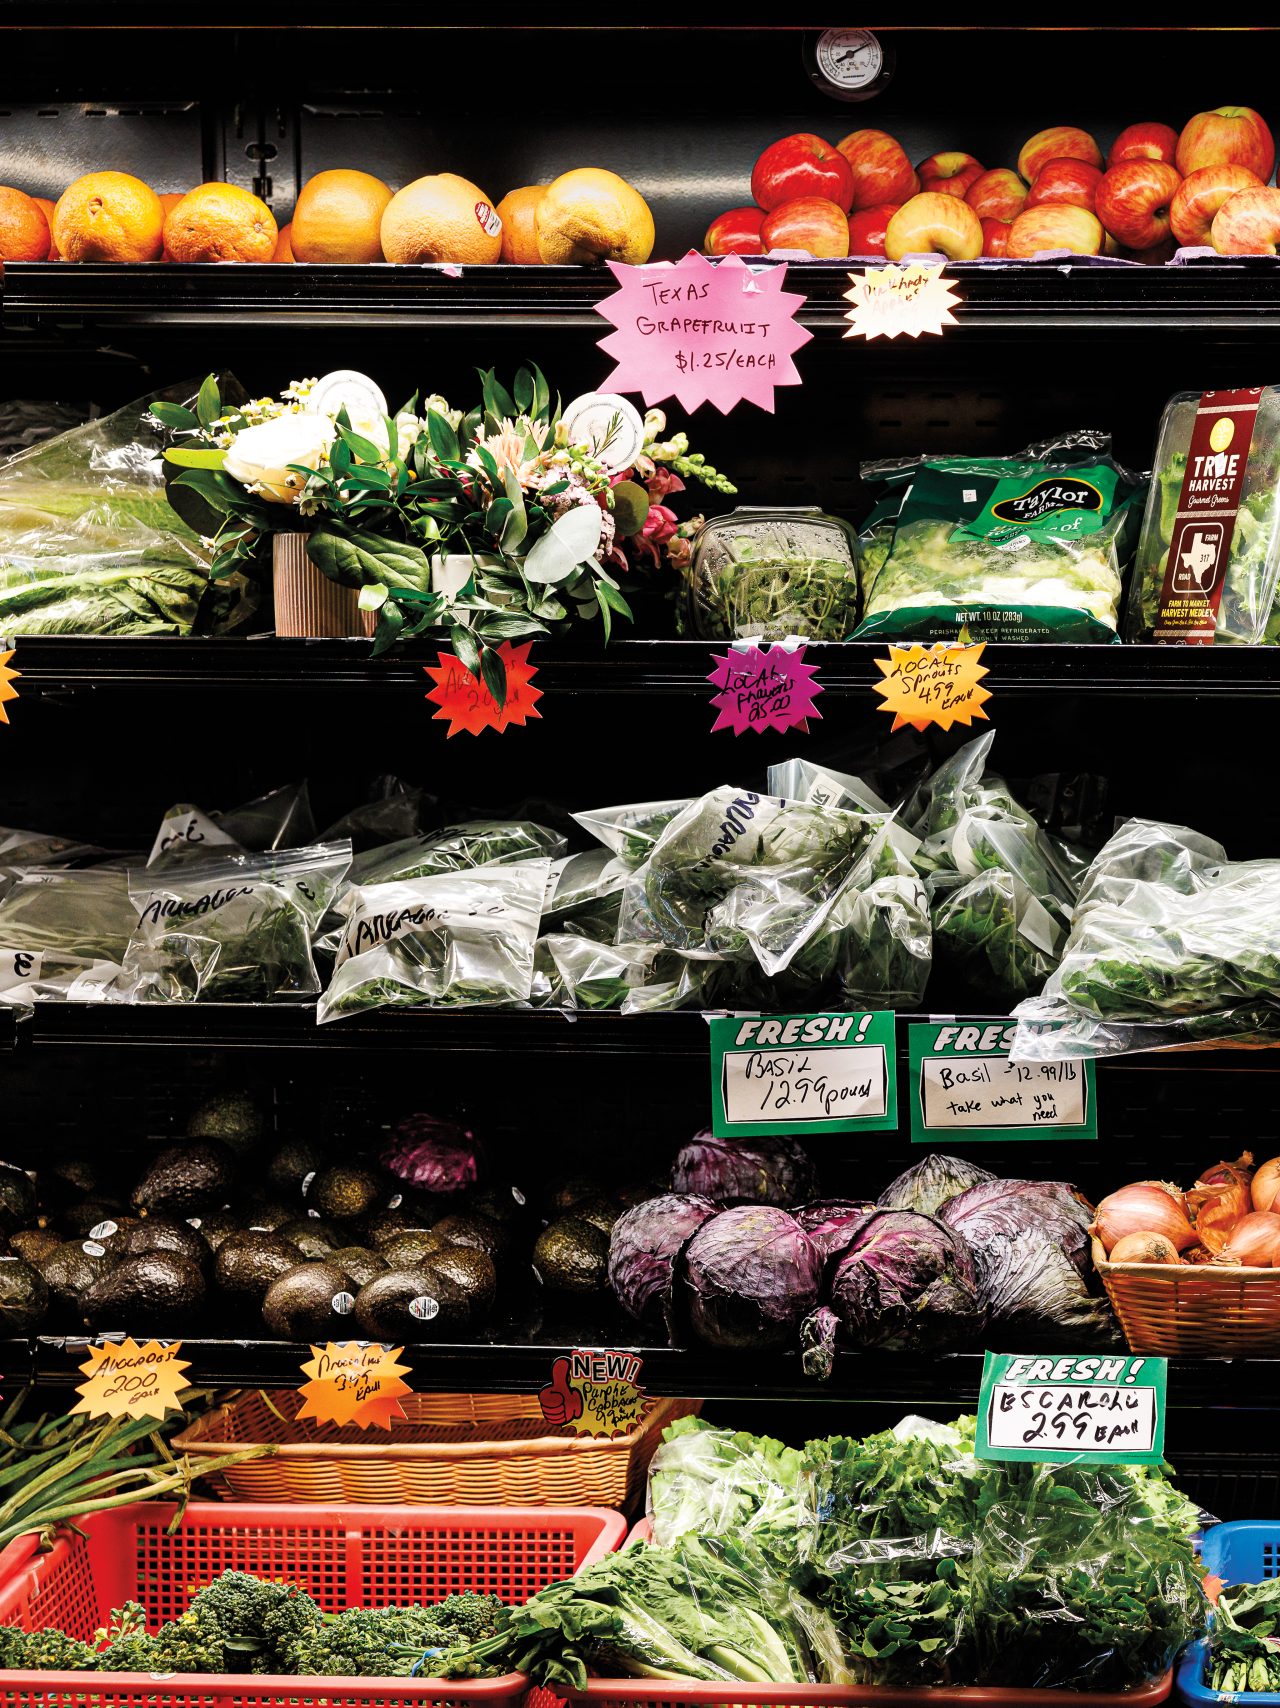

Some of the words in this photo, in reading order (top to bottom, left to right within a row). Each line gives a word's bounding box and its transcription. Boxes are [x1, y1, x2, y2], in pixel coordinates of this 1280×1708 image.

[643, 281, 710, 307] TEXAS
[1188, 478, 1236, 492] HARVEST
[1013, 486, 1089, 511] Taylor
[955, 612, 968, 622] NET
[968, 612, 982, 622] WT.
[983, 611, 992, 621] 10
[992, 611, 1001, 621] OZ
[1002, 611, 1023, 623] (283g)
[1161, 608, 1188, 618] HARVEST
[891, 655, 955, 679] LOCAL
[901, 664, 962, 695] Sprouts
[735, 1014, 874, 1047] FRESH!
[939, 1062, 992, 1091] Basil
[760, 1075, 829, 1111] 12.99
[946, 1100, 982, 1116] take
[991, 1092, 1023, 1108] what
[1033, 1091, 1055, 1110] you
[1032, 1104, 1058, 1122] need
[572, 1353, 640, 1383] NEW!
[1004, 1356, 1147, 1385] FRESH!
[1022, 1411, 1094, 1444] 2.99
